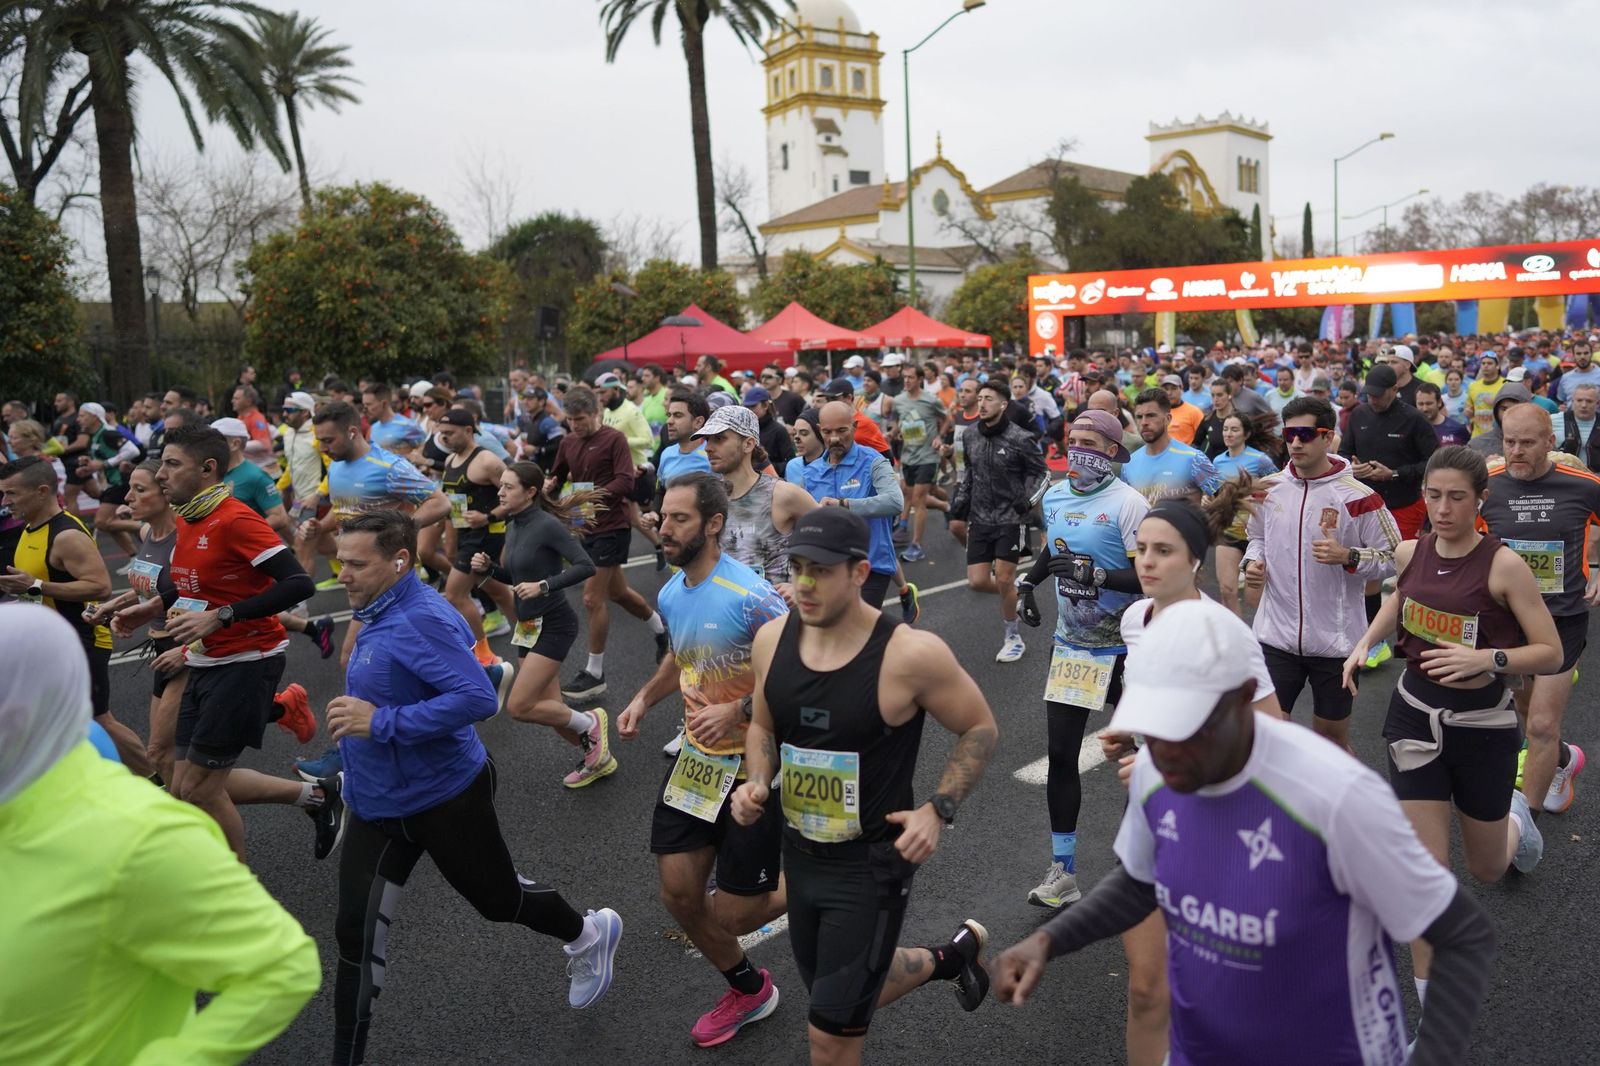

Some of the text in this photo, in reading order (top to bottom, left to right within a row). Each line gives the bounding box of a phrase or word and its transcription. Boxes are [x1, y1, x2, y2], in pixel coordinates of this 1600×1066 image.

[1409, 603, 1462, 637] 11608
[1056, 661, 1099, 684] 13871
[681, 756, 724, 789] 13281
[785, 768, 844, 803] 12200
[1155, 880, 1180, 916] EL
[1180, 894, 1280, 947] GARBÍ
